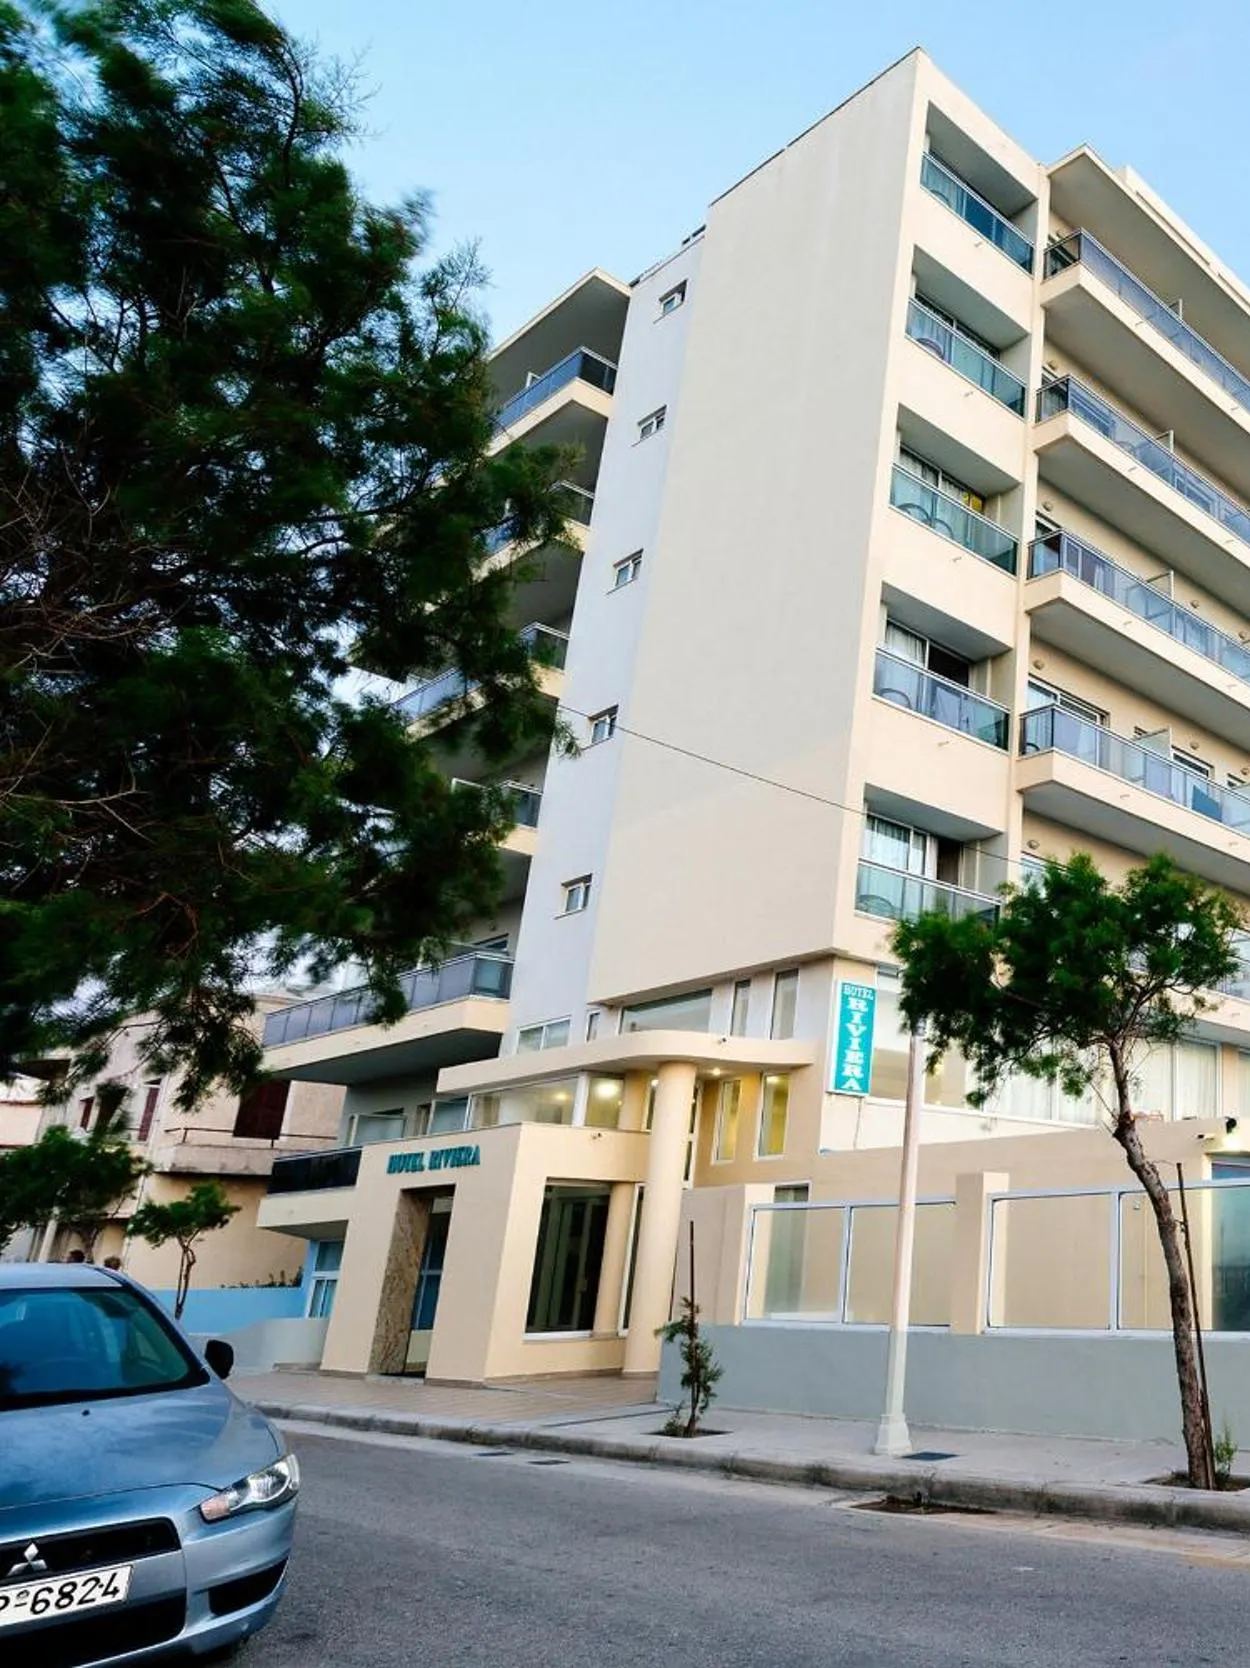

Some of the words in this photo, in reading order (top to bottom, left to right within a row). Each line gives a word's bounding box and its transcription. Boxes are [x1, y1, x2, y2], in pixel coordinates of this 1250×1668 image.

[841, 996, 869, 1091] RIVIERA
[386, 1151, 425, 1175] HOTEL
[428, 1144, 481, 1171] RIVIERA
